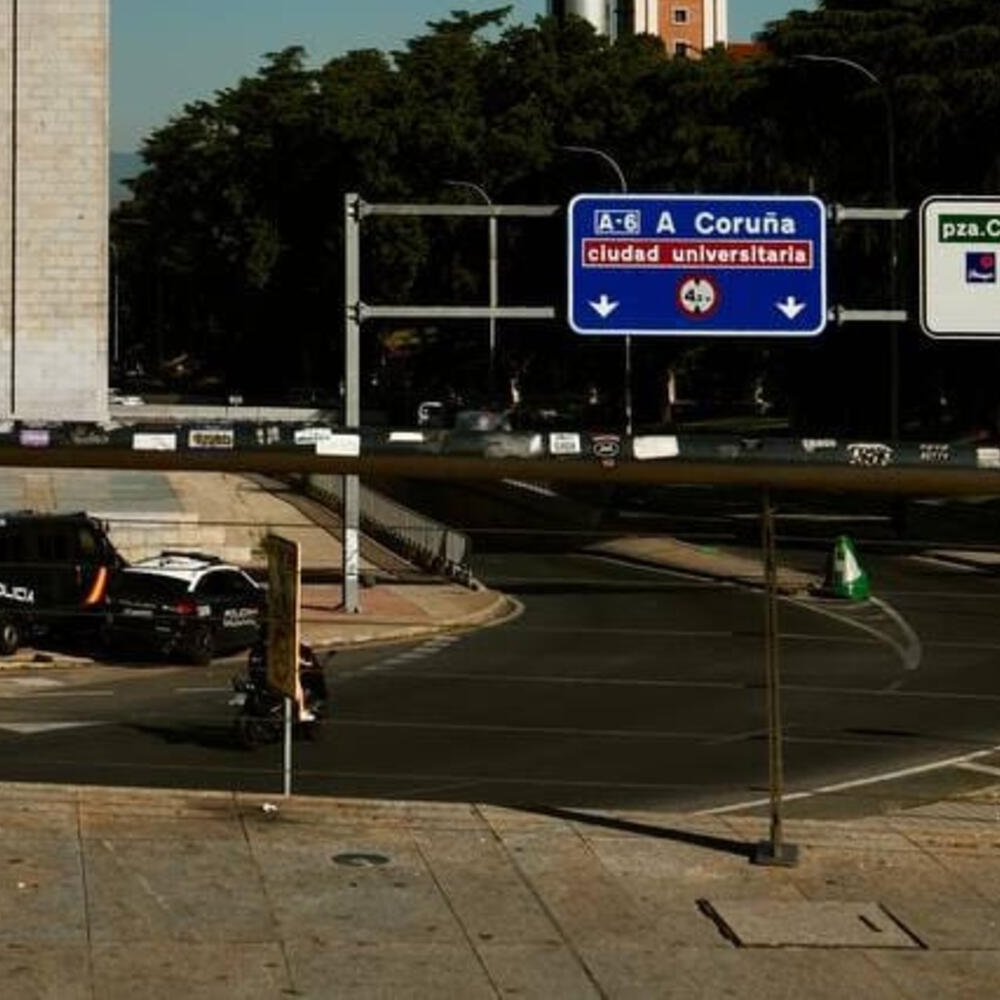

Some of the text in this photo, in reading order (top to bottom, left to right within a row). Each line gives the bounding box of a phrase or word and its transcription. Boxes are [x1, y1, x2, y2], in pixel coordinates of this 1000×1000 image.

[600, 211, 796, 235] A-6 A Coruña
[587, 245, 807, 264] ciudad universitaria
